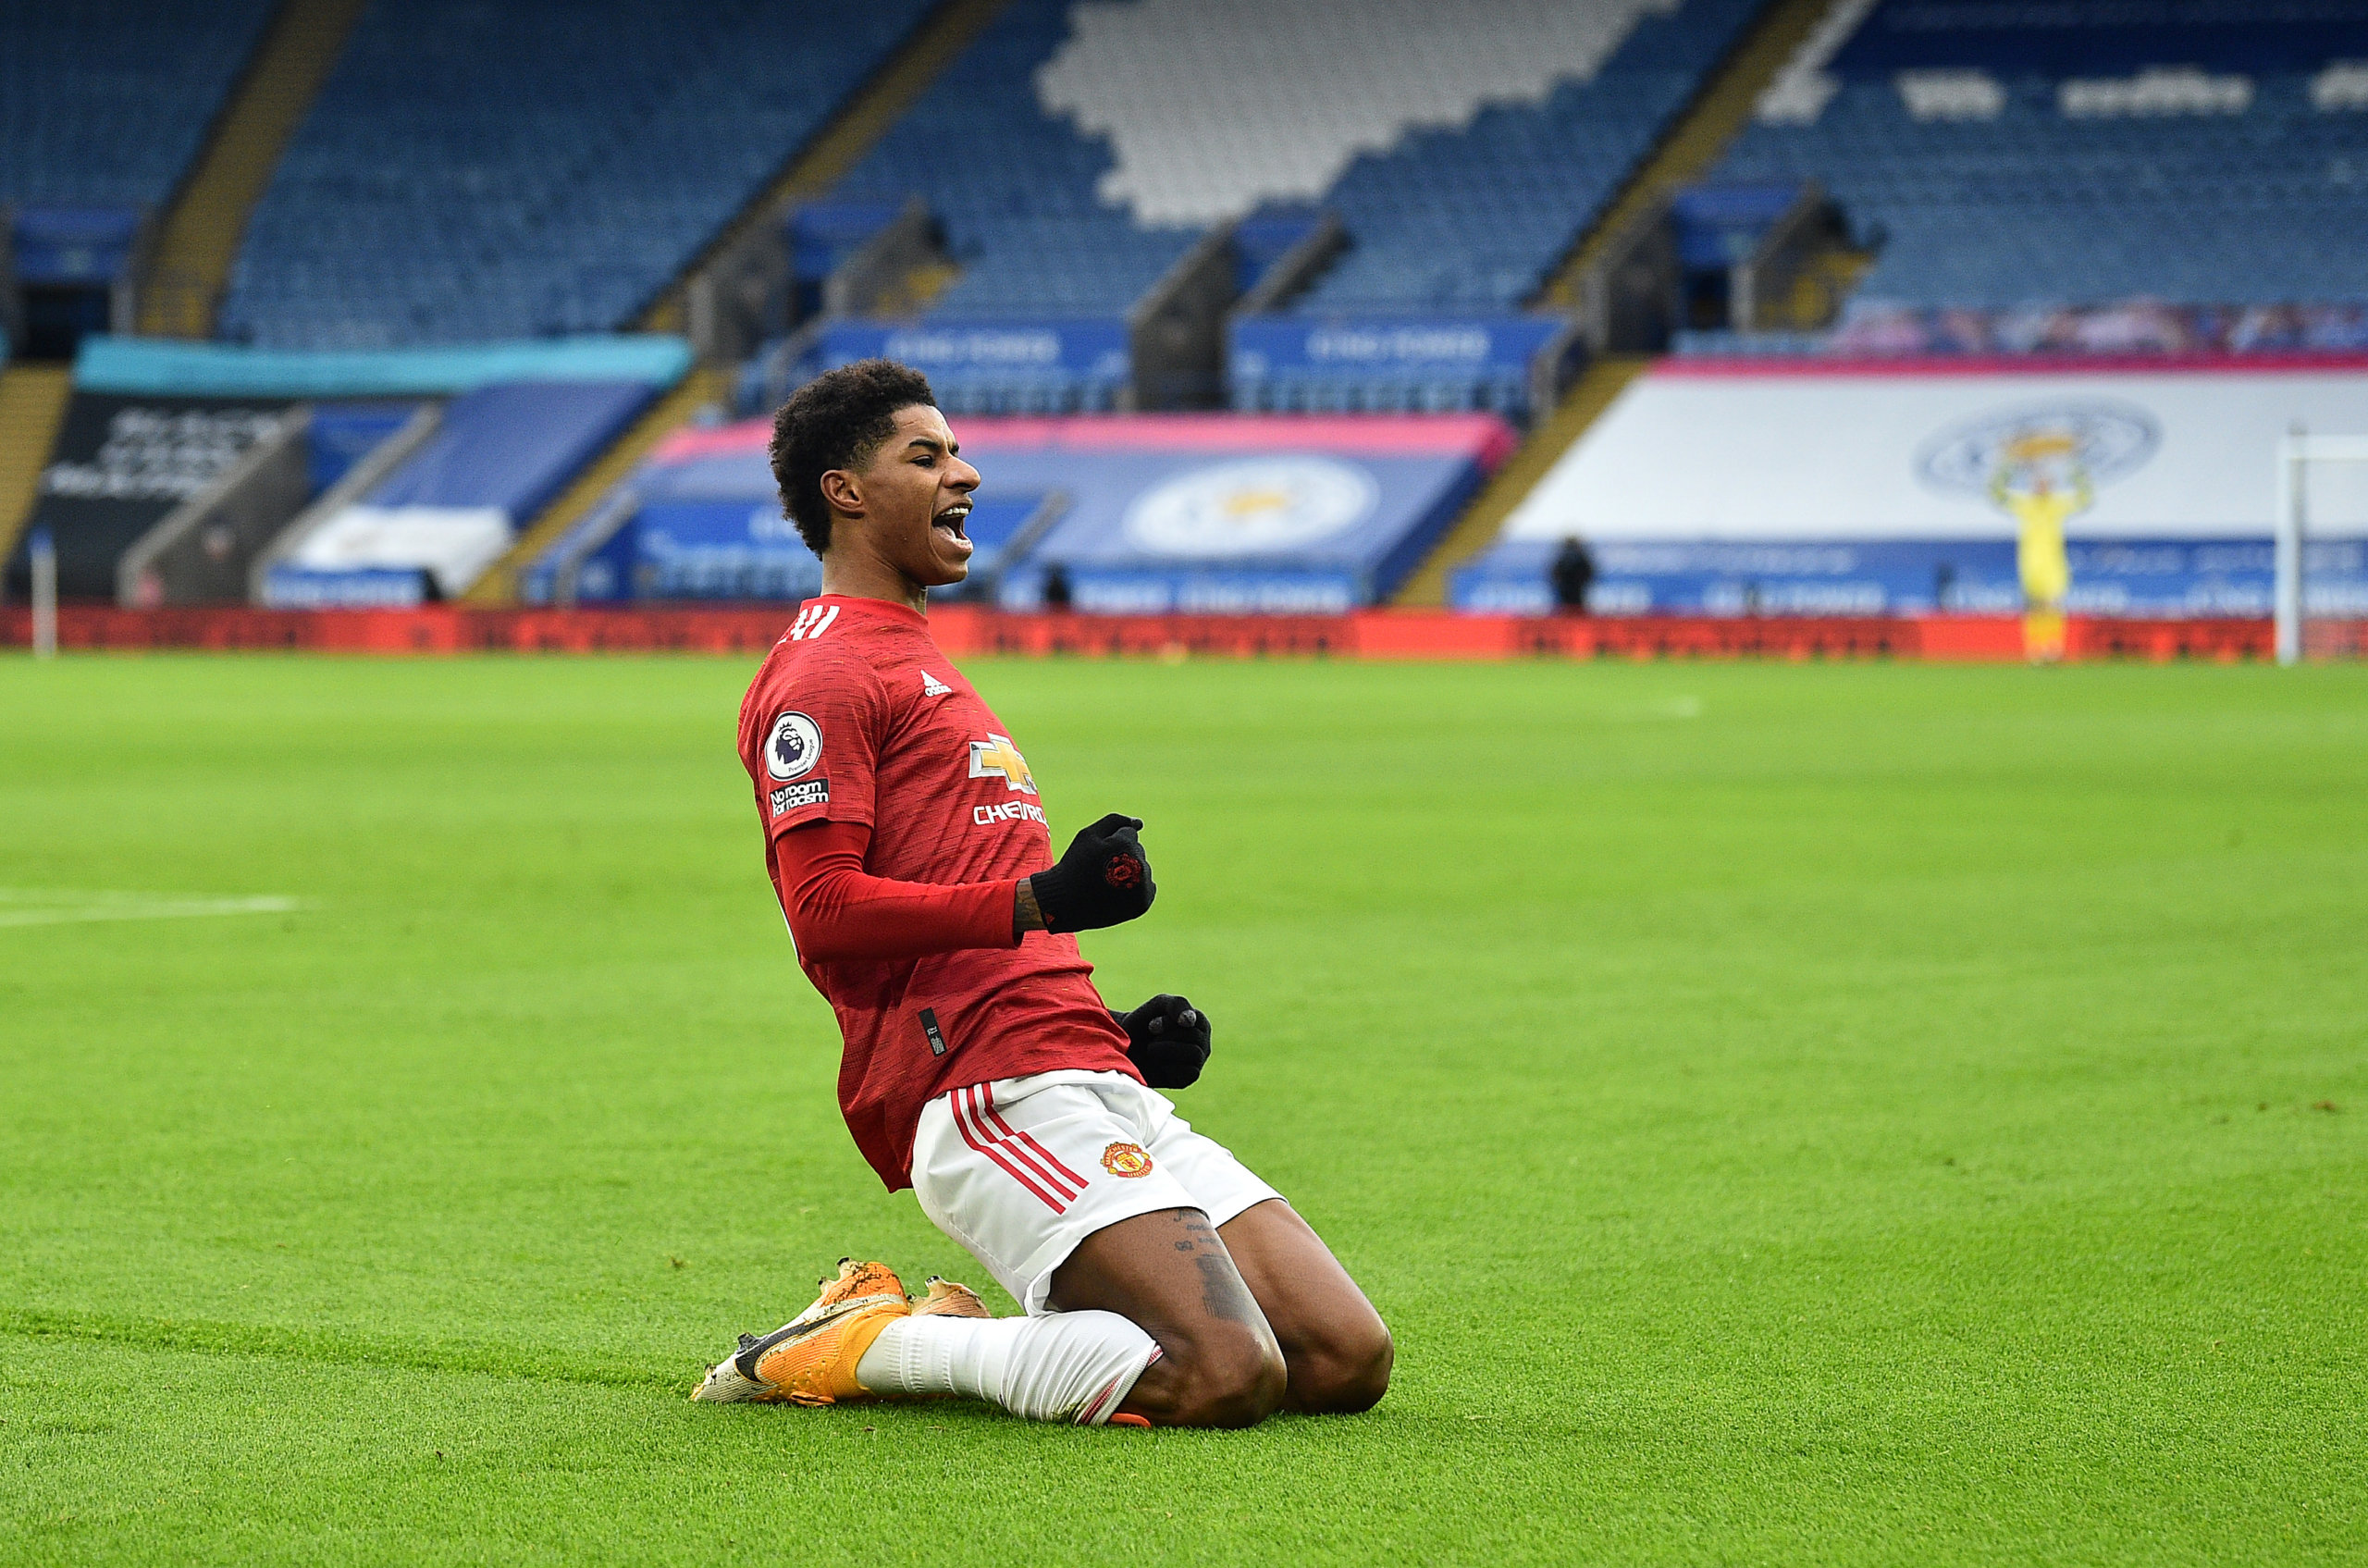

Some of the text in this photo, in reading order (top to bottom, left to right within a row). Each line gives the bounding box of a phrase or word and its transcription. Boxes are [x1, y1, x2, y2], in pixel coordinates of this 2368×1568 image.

[788, 738, 815, 772] Premier League
[770, 782, 821, 804] No room
[772, 792, 829, 818] for racism
[973, 800, 1049, 829] CHEVRO
